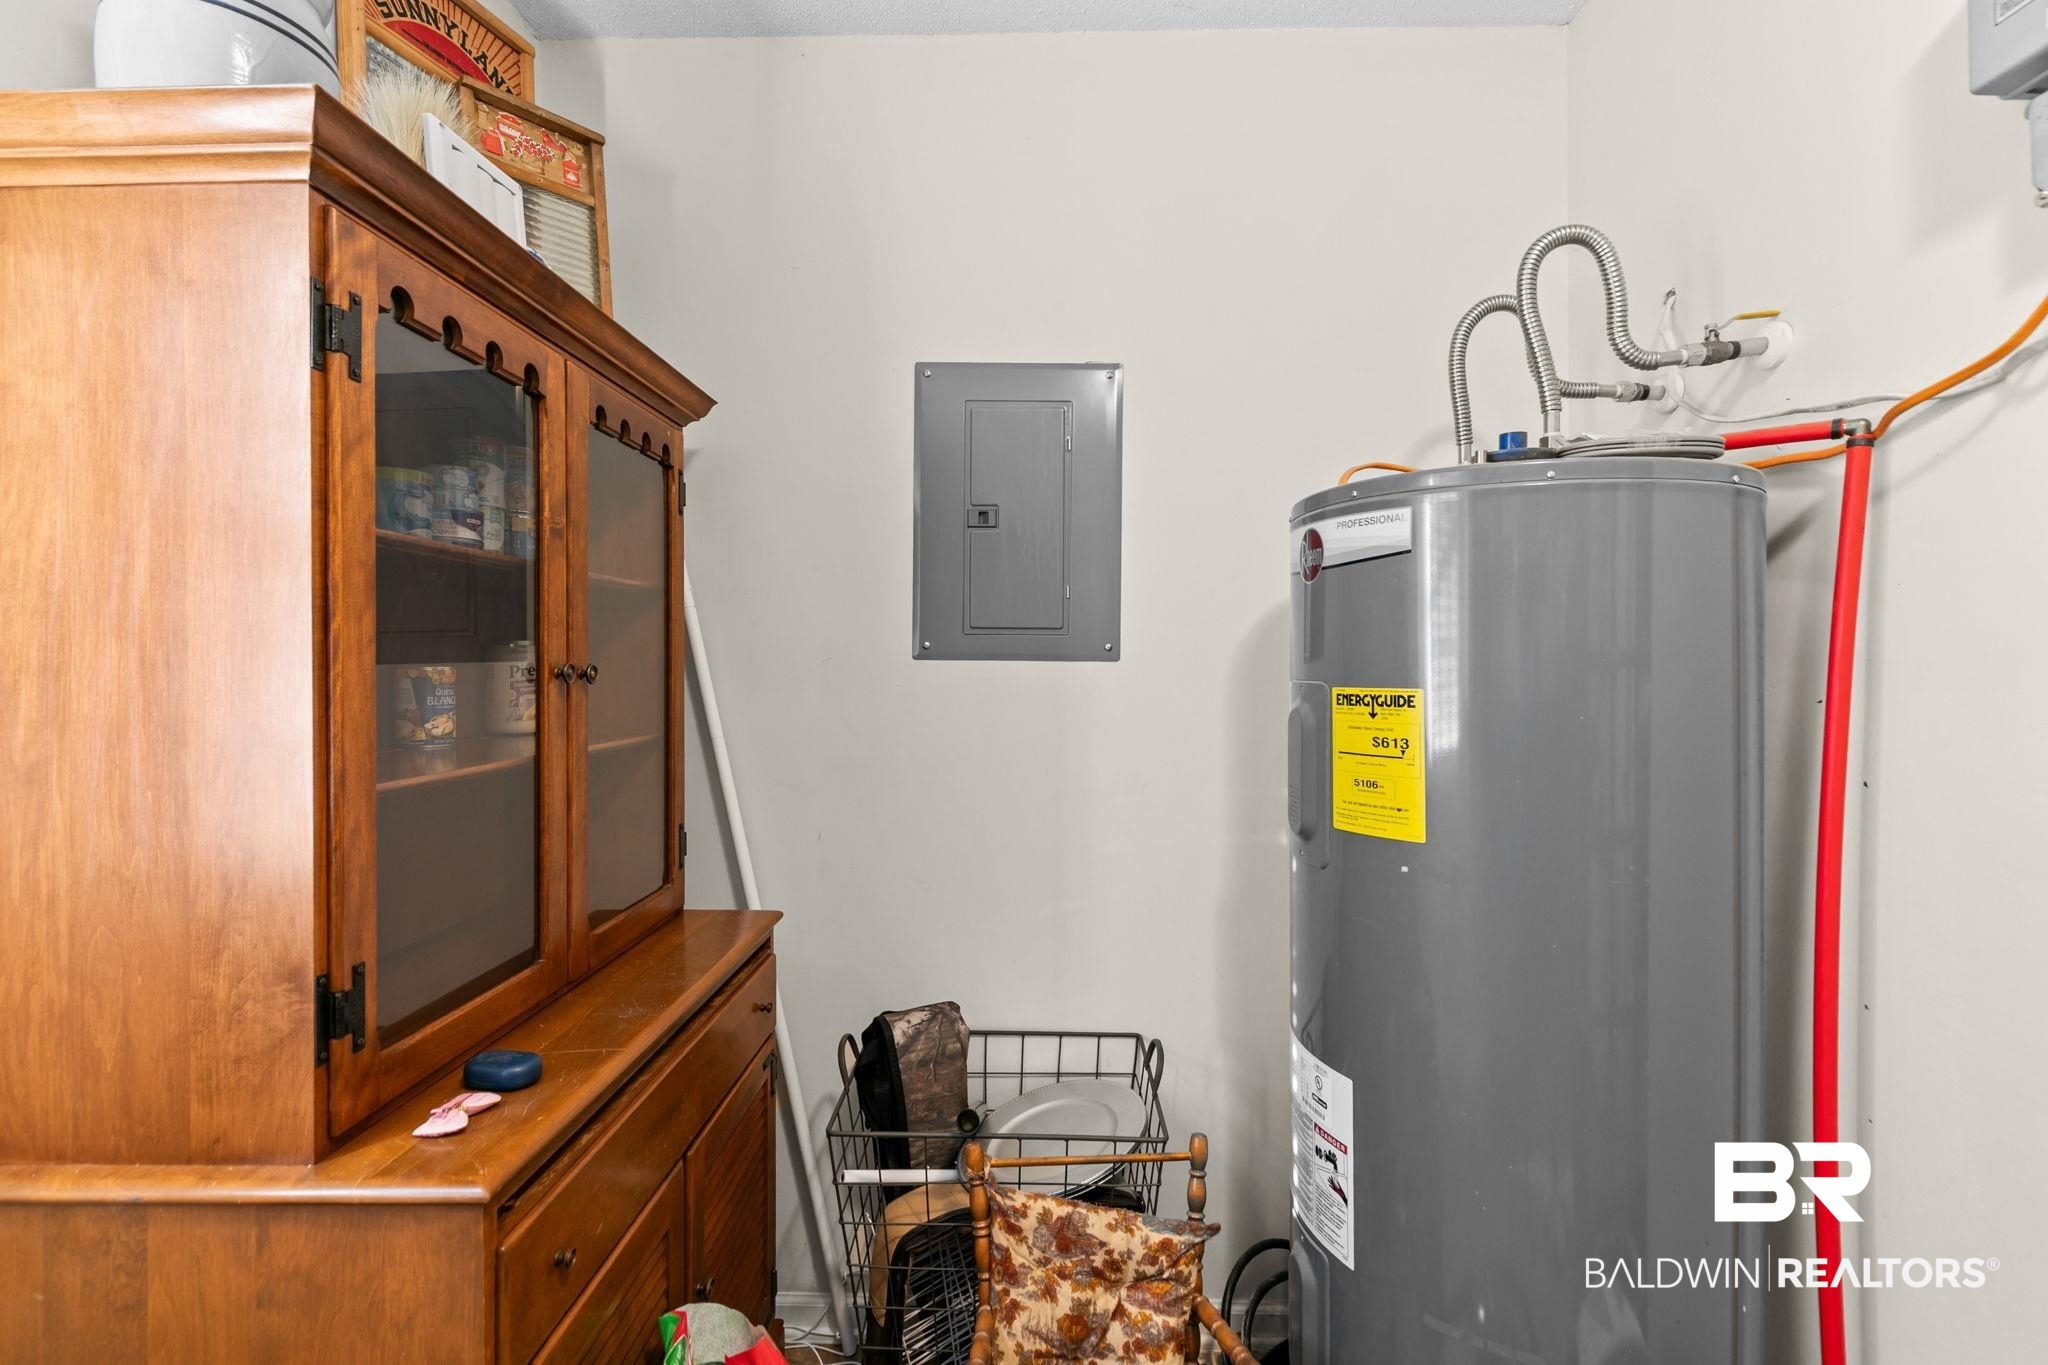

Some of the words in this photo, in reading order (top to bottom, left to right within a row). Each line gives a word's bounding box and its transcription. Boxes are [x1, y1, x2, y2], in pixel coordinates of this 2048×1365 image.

[1336, 513, 1406, 531] PROFESSIONAL
[1336, 693, 1416, 709] ENERGYGUIDE
[1372, 736, 1410, 750] $613
[1354, 778, 1379, 789] 5106
[1320, 1130, 1346, 1153] DANGER
